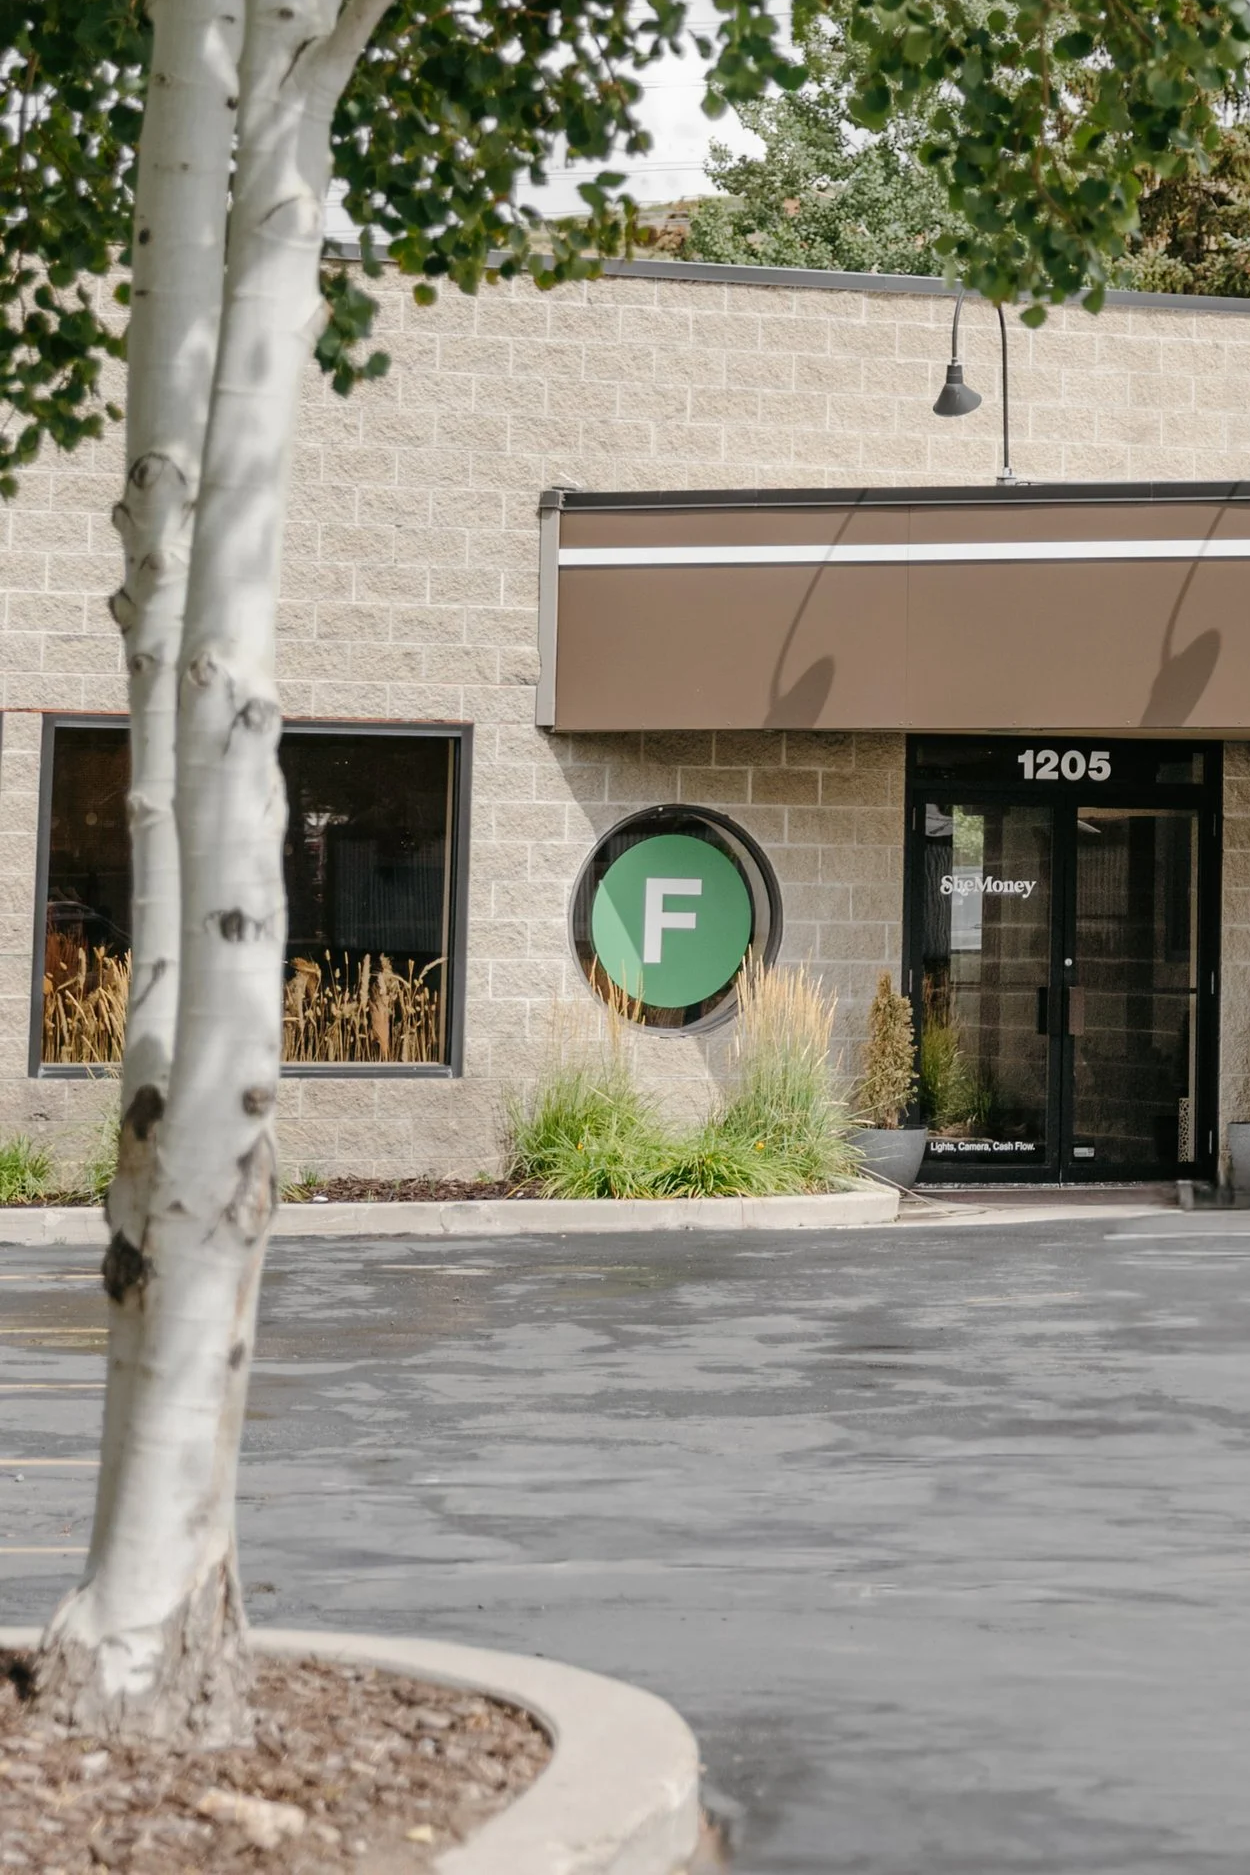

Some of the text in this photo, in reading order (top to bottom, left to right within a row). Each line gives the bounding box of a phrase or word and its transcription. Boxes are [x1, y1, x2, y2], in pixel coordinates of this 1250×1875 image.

[1017, 749, 1112, 781] 1205
[940, 875, 1037, 899] SheMoney
[643, 878, 703, 964] F
[930, 1141, 1036, 1153] Lights, Camera, Cash Flow.
